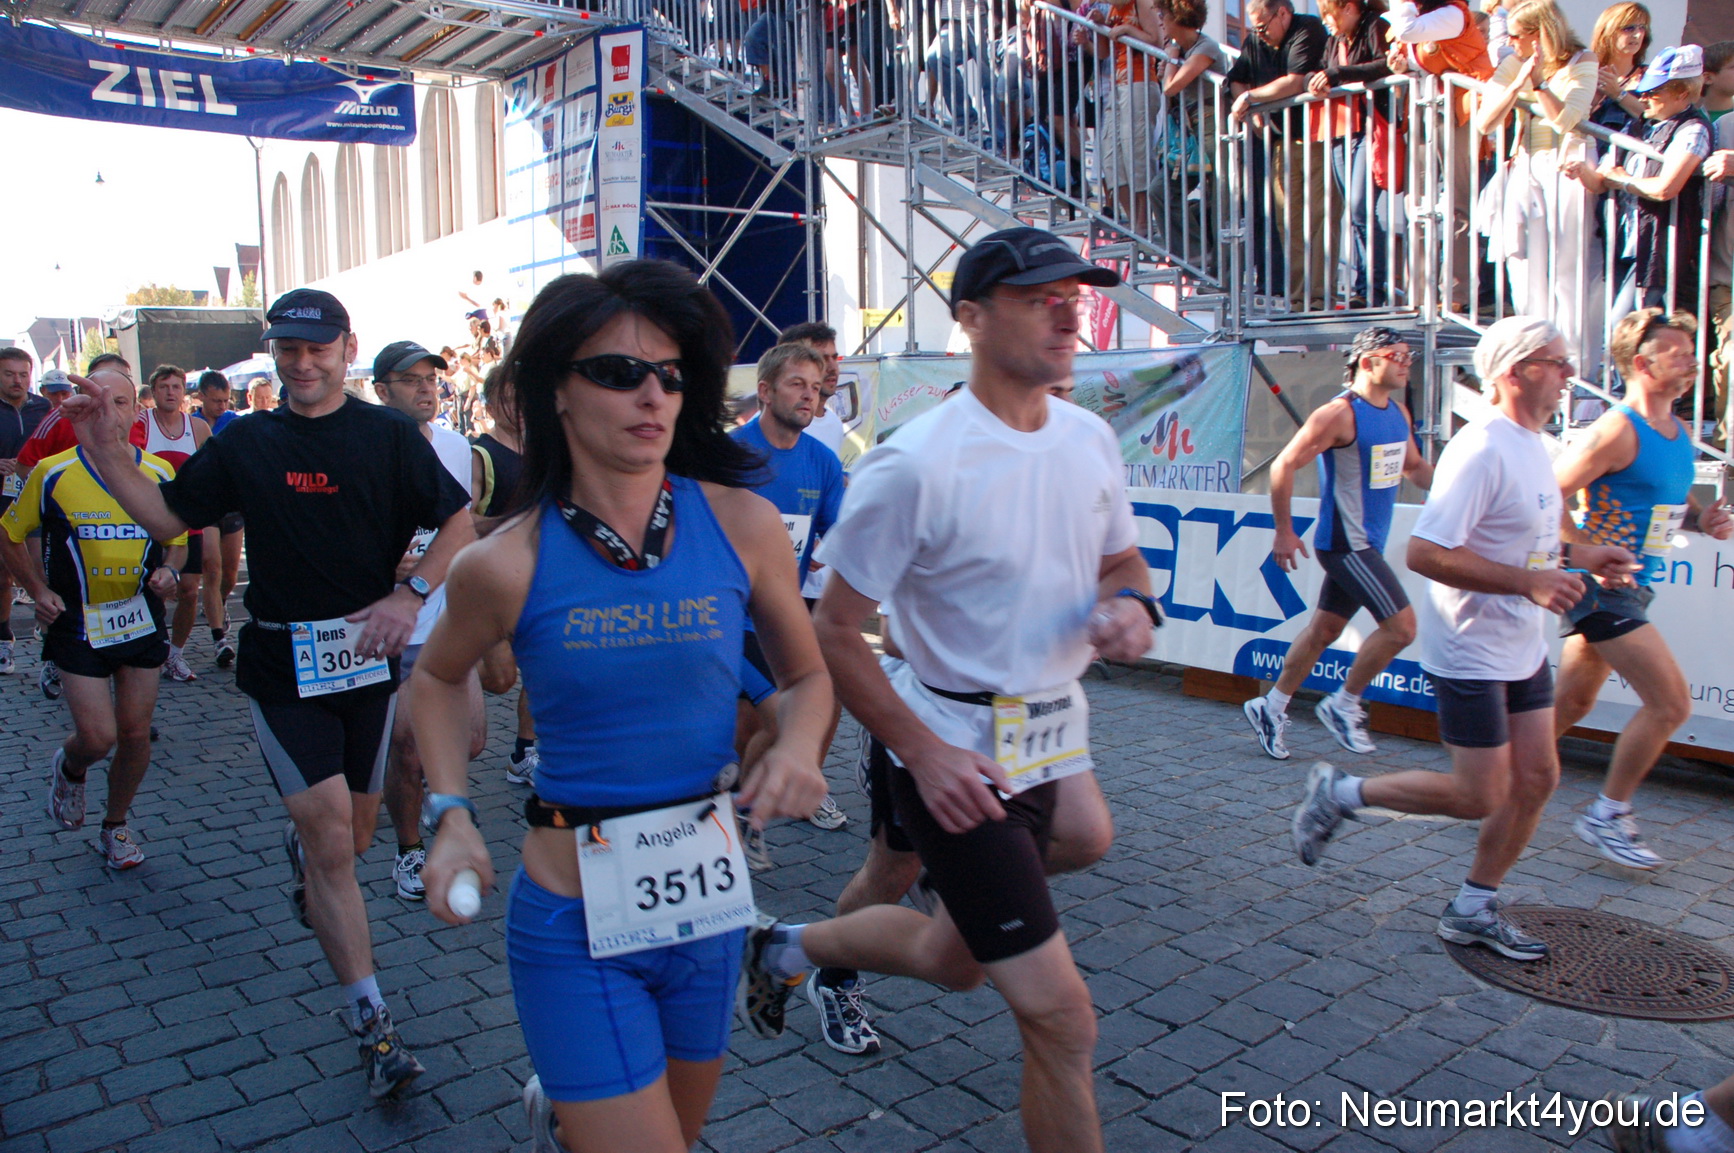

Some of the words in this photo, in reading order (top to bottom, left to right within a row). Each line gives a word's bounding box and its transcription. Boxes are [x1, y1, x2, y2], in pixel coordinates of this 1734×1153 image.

[88, 59, 237, 116] ZIEL
[334, 101, 399, 117] MIZUNO
[326, 121, 406, 131] www.mizunoeurope.com
[286, 471, 329, 487] WILD
[107, 609, 144, 630] 1041
[662, 596, 718, 628] LINE
[316, 628, 346, 643] Jens
[300, 650, 312, 662] A
[321, 649, 380, 673] 305
[635, 821, 699, 850] Angela
[636, 857, 736, 912] 3513
